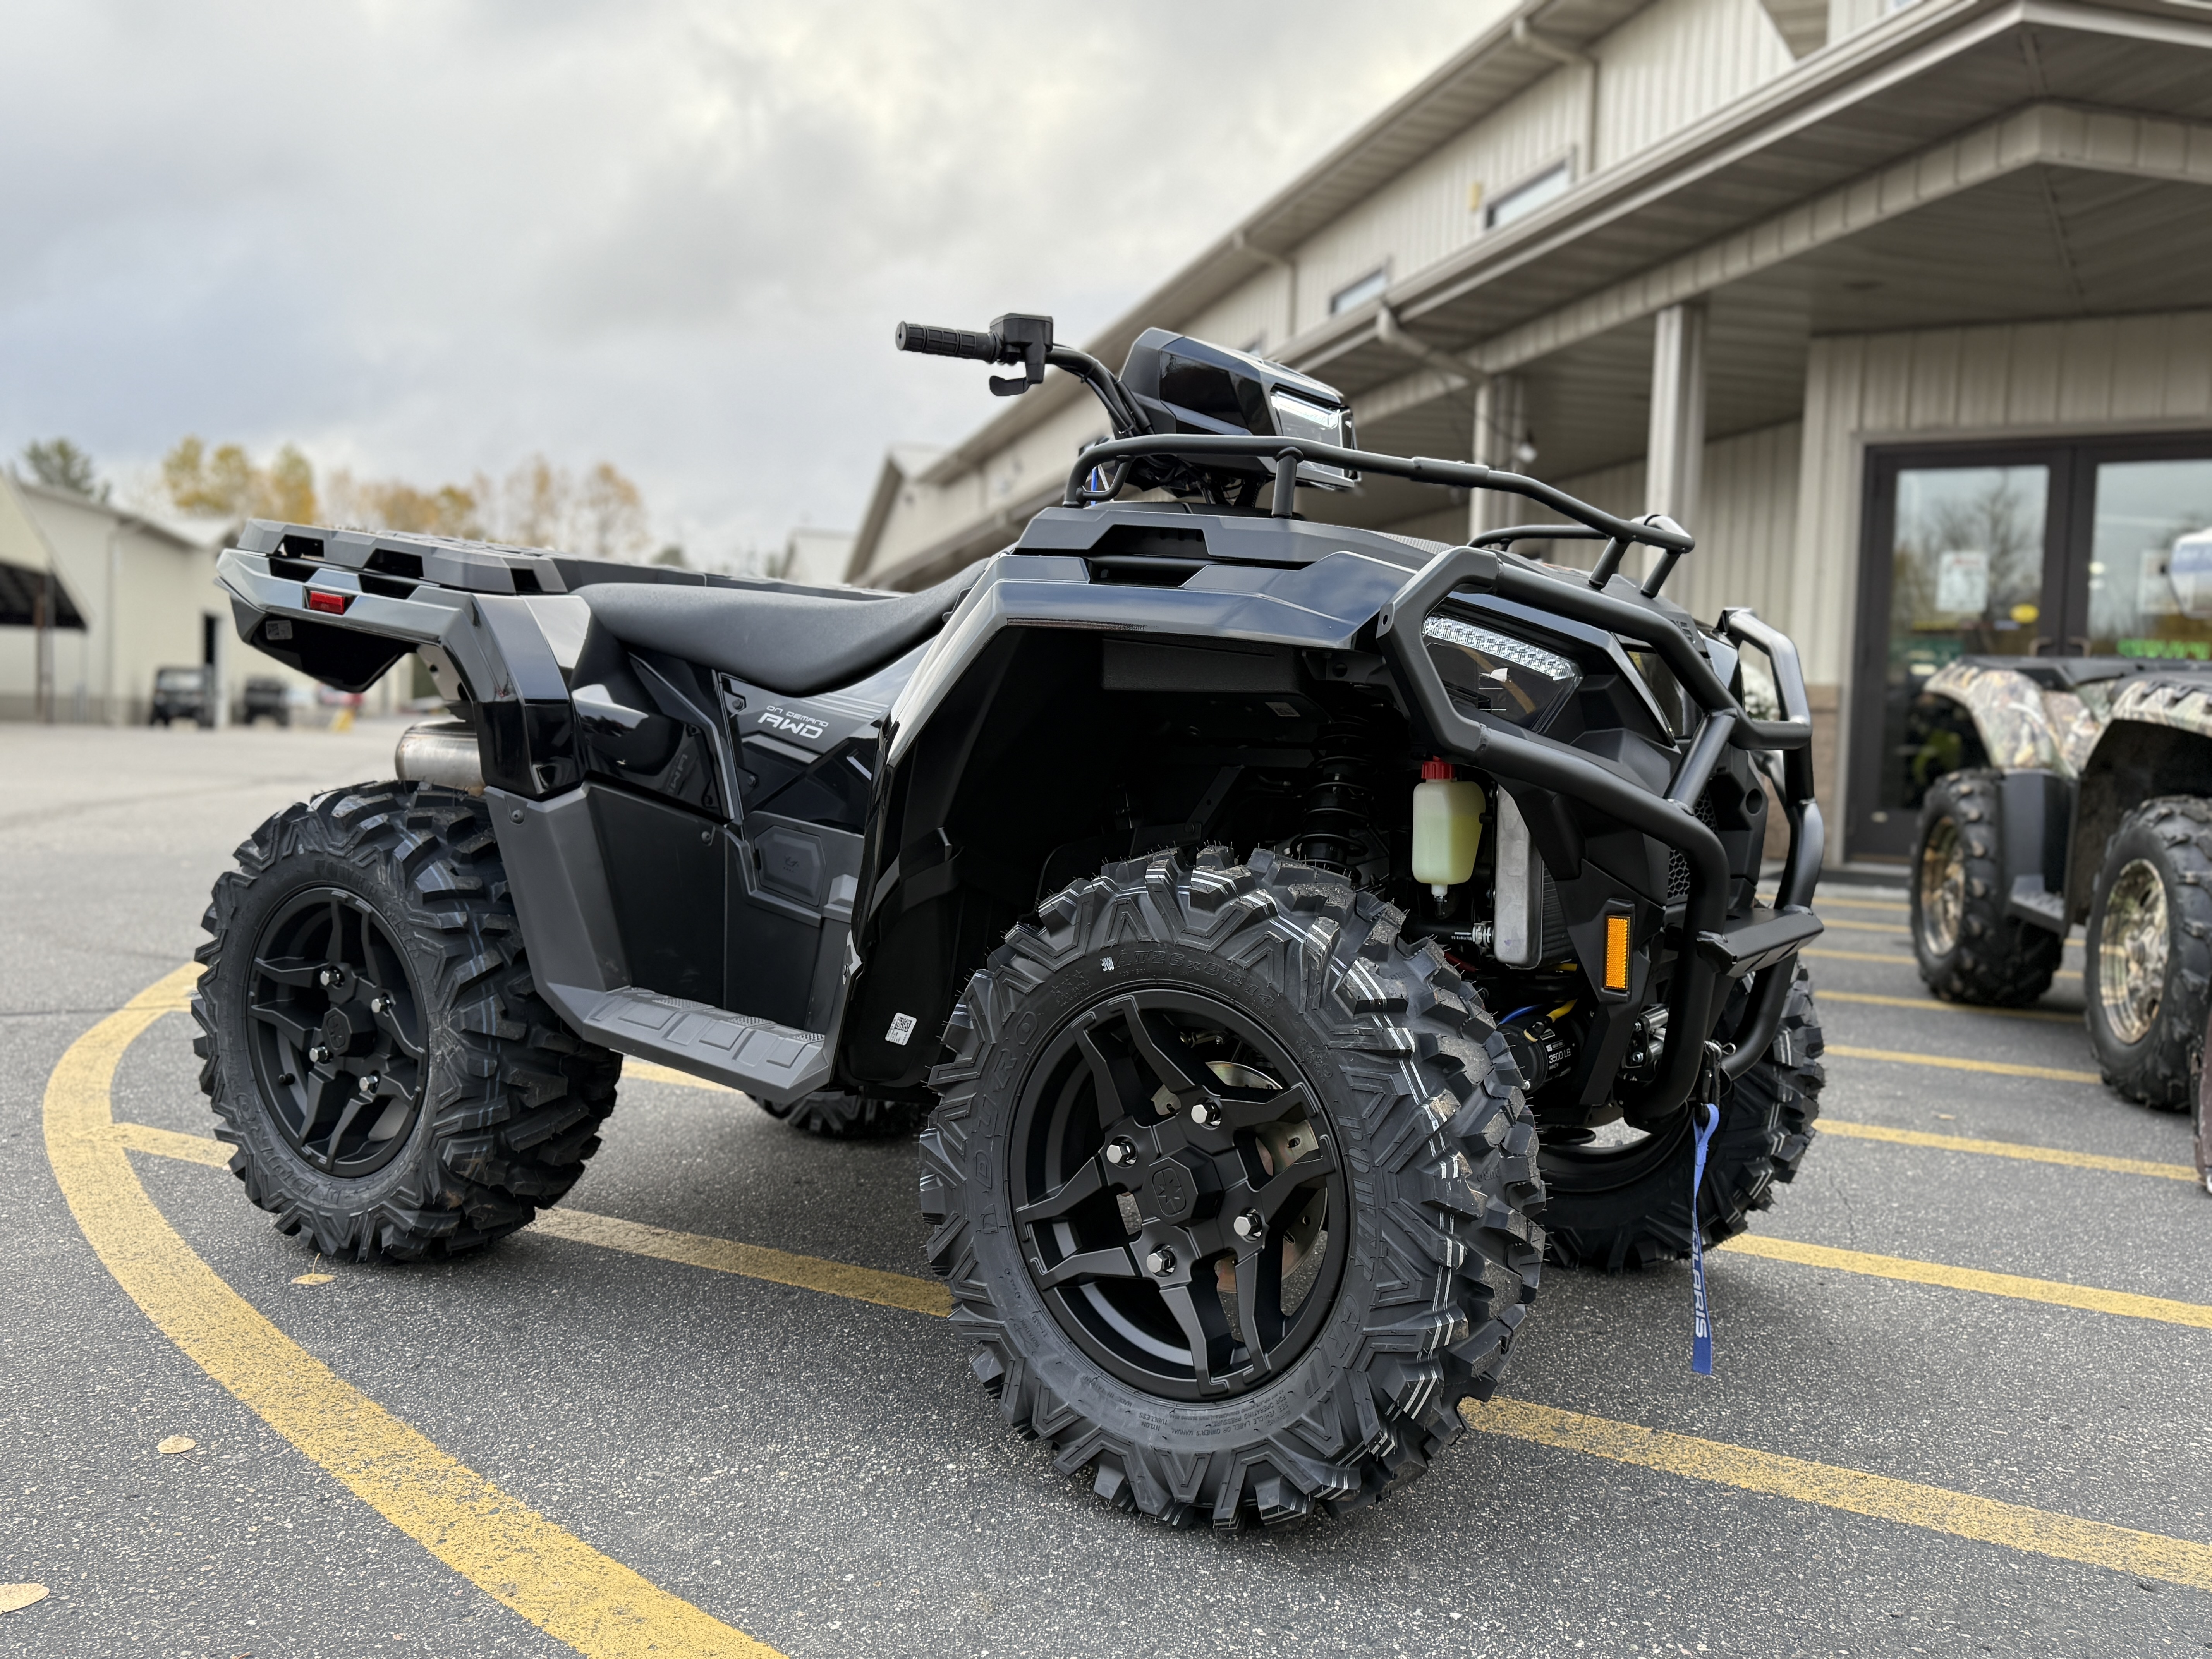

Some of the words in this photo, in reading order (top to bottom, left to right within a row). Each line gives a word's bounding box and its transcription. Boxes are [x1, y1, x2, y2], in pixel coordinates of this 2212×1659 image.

[758, 712, 823, 739] AWD
[766, 705, 782, 714] ON
[786, 711, 829, 727] DEMAND
[1304, 1294, 1362, 1399] GRIP
[1243, 1401, 1274, 1420] OPERATING
[1252, 1409, 1276, 1425] VEHICLE
[1233, 1420, 1251, 1431] LABEL
